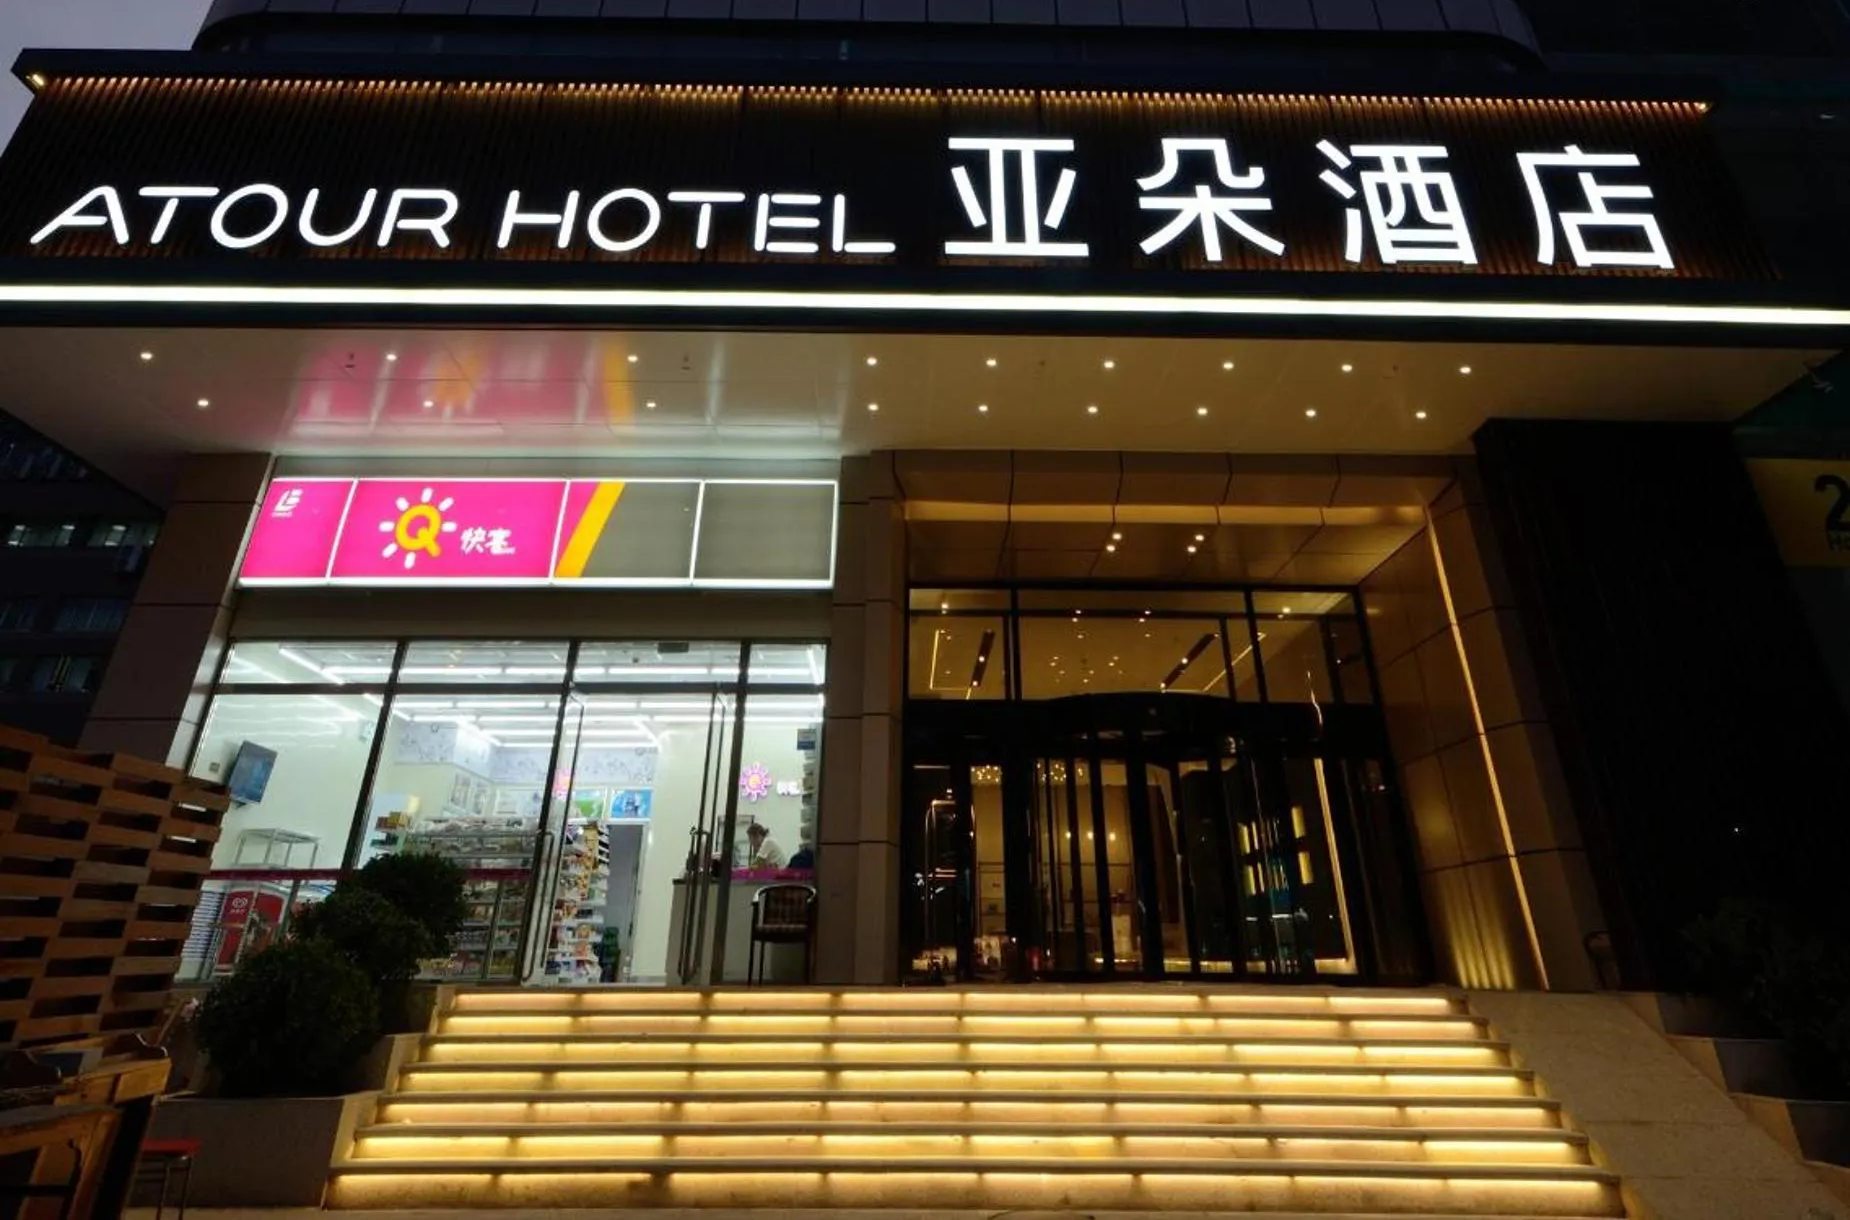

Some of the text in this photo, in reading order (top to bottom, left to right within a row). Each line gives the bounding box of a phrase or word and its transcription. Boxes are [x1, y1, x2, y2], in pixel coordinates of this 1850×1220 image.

[29, 182, 897, 254] ATOUR HOTEL
[944, 136, 1675, 269] 亚朵酒店
